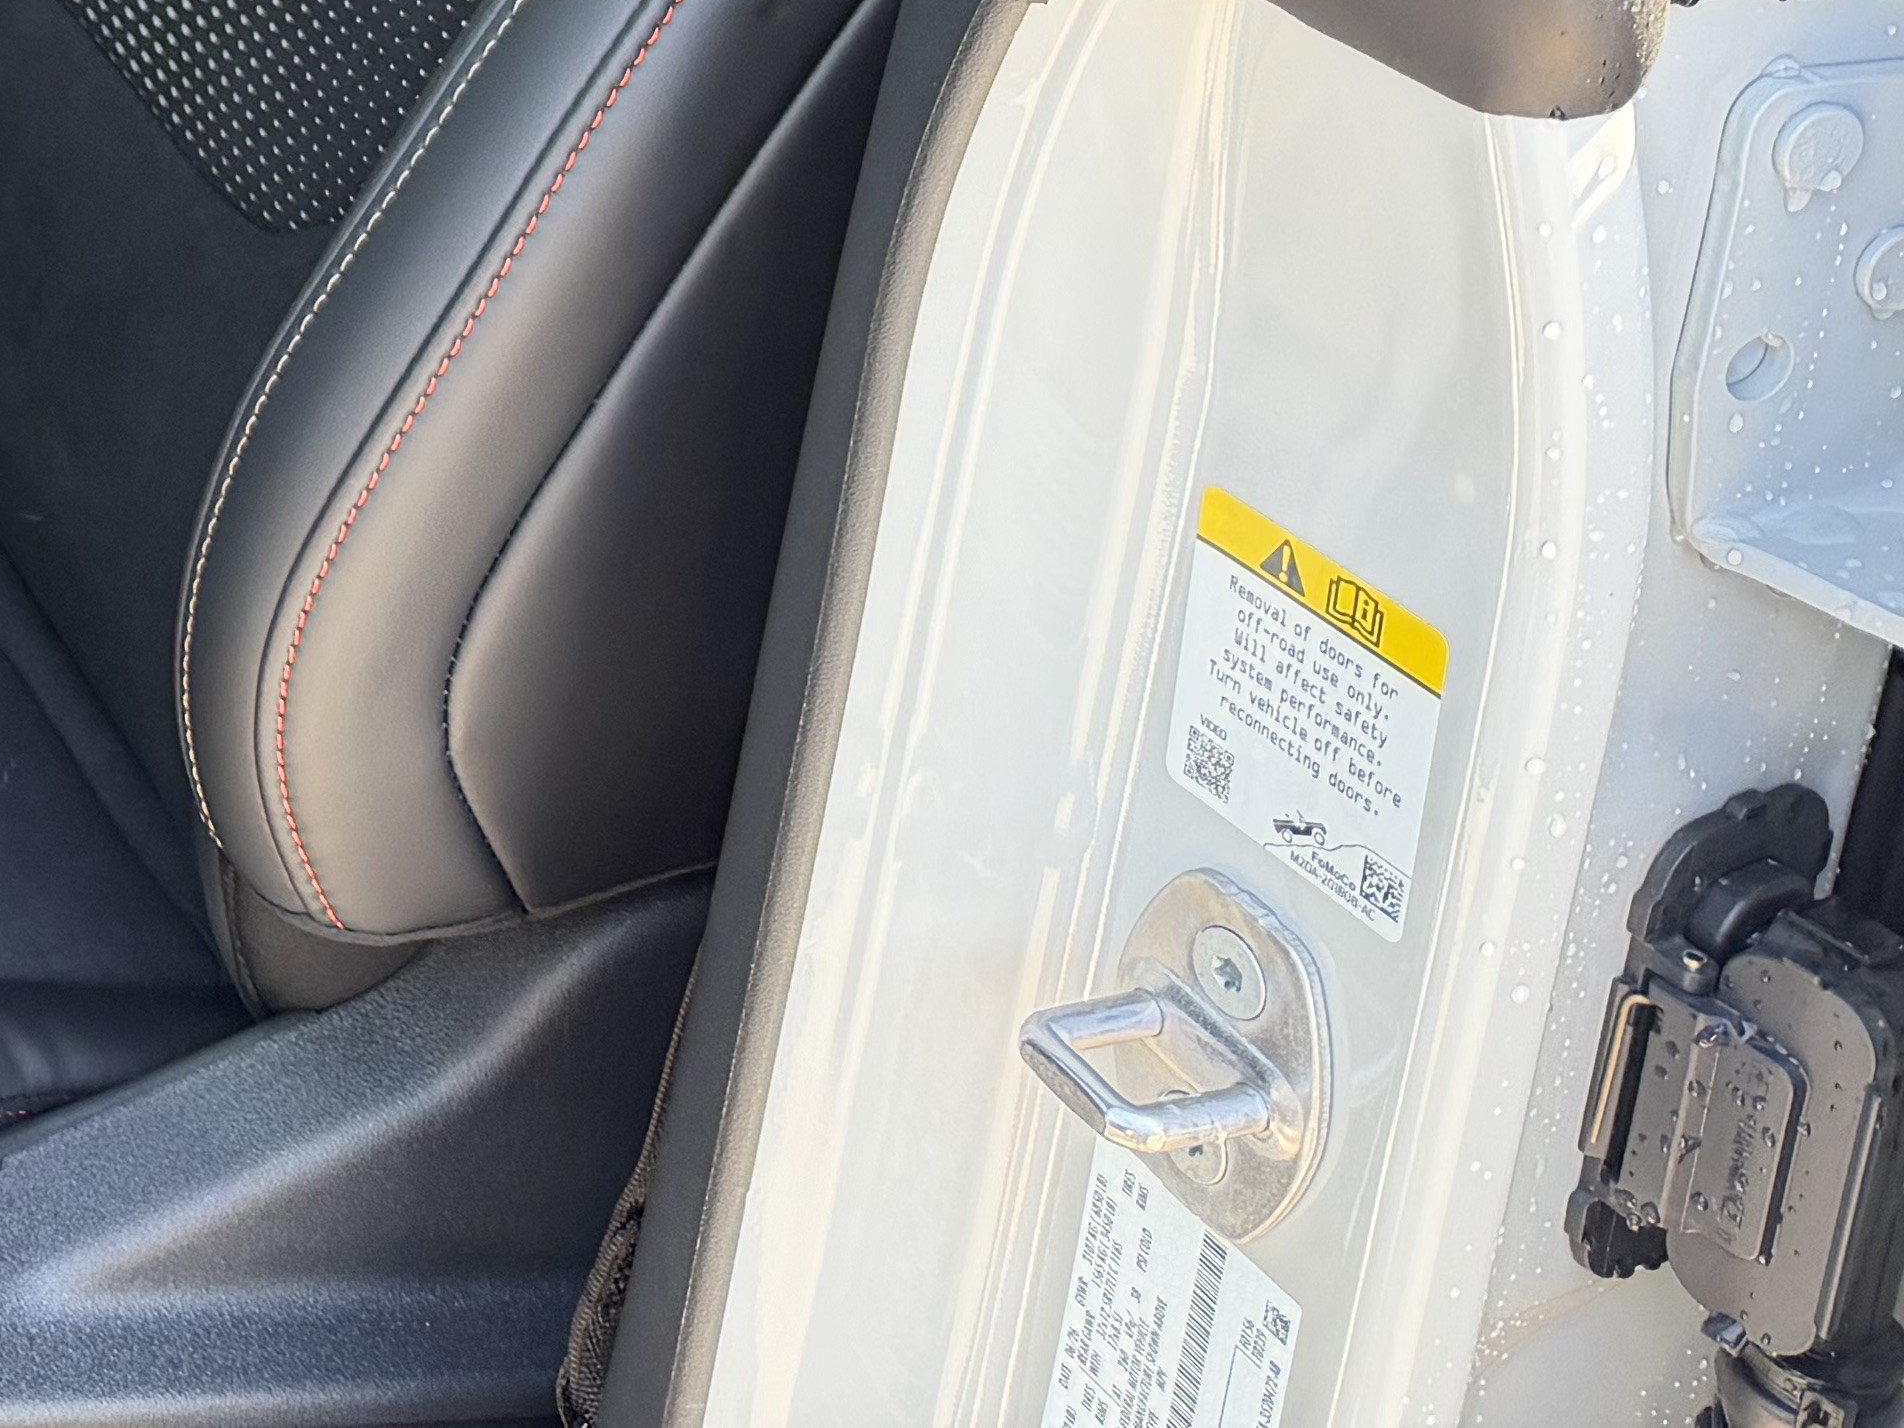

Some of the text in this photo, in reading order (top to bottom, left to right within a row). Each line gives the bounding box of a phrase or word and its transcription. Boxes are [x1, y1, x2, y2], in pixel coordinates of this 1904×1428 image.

[1229, 575, 1398, 698] Removal of doors for
[1234, 627, 1387, 748] Will affect safety
[1237, 609, 1388, 719] off-road use only.
[1209, 658, 1400, 807] Turn vehicle off before
[1220, 696, 1377, 815] reconnecting doors.
[1223, 648, 1380, 765] system performance.
[1311, 851, 1355, 891] FoMoCo
